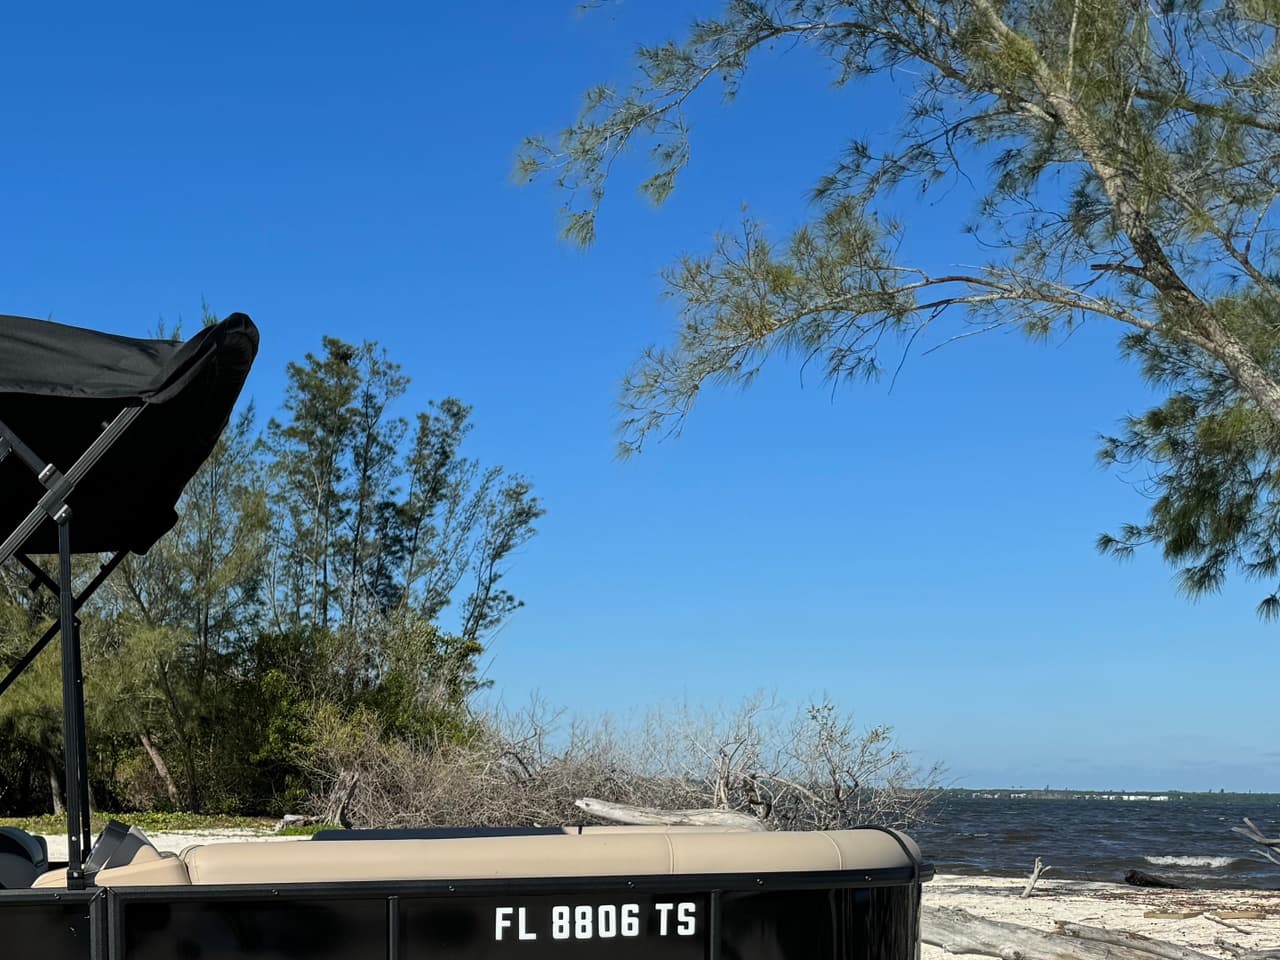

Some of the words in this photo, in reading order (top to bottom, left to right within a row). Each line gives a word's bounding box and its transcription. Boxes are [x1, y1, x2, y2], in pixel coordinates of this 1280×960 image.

[495, 907, 537, 941] FL
[553, 904, 640, 939] 8806
[655, 903, 696, 936] TS
